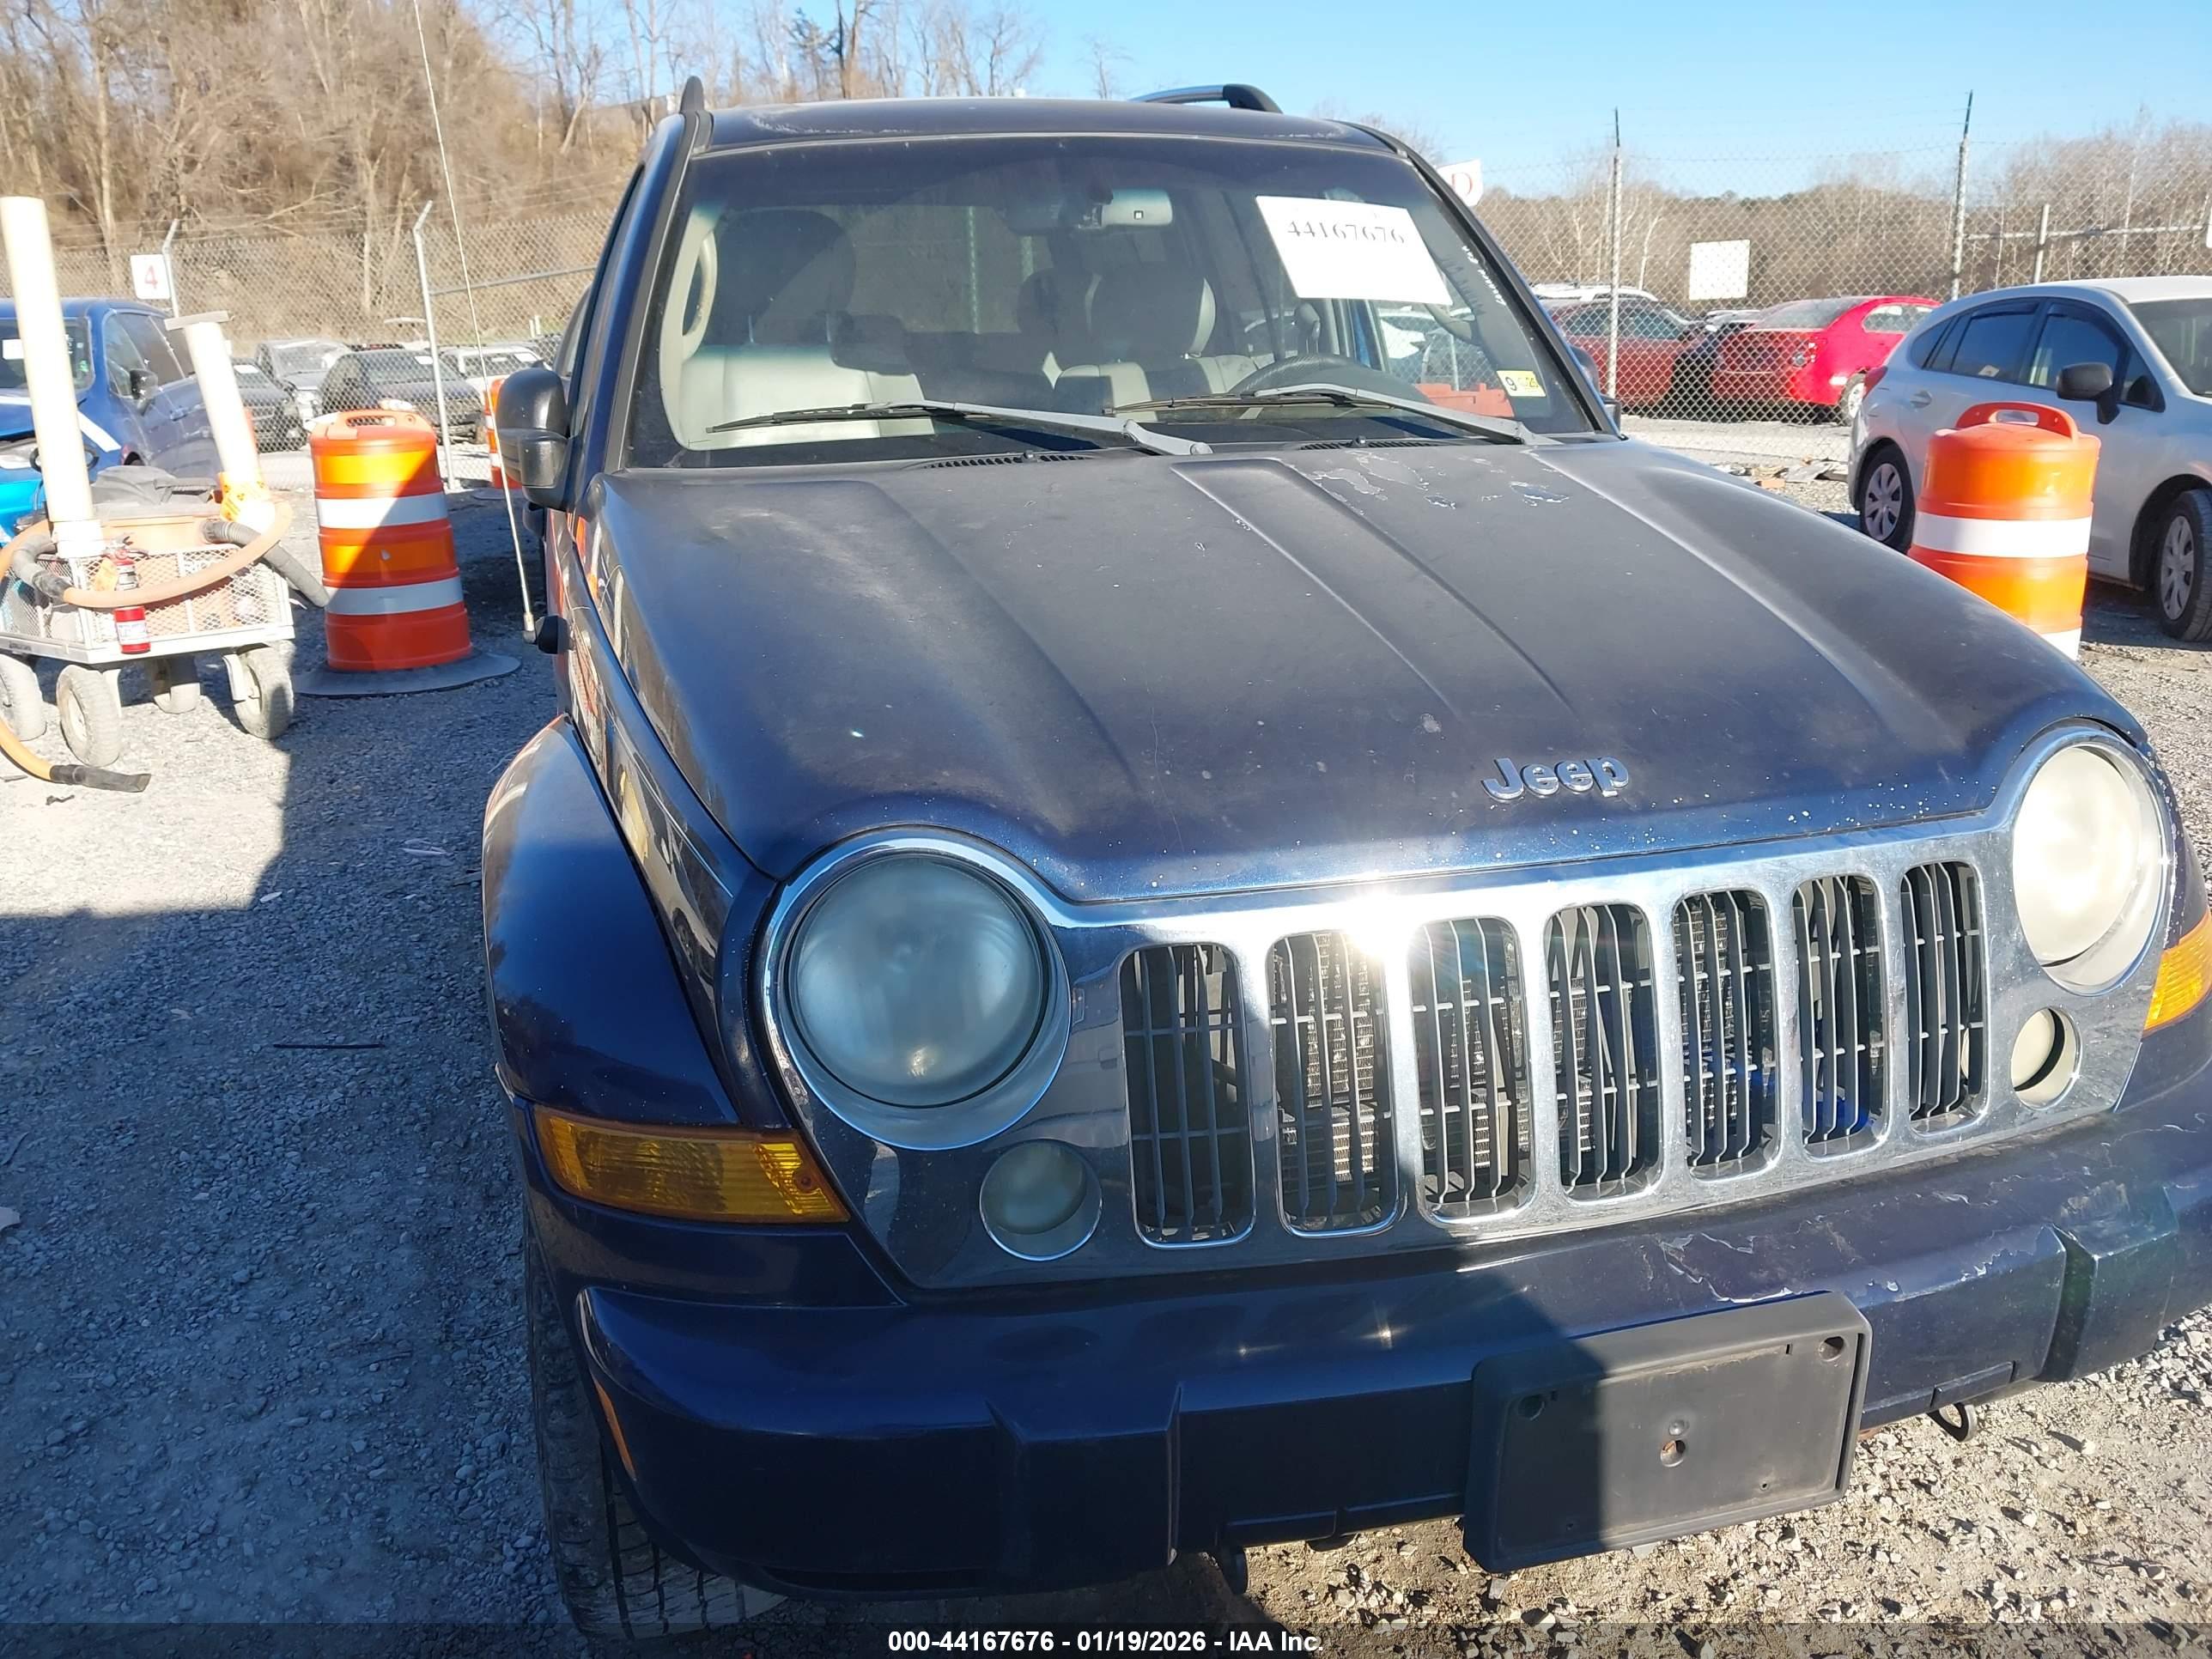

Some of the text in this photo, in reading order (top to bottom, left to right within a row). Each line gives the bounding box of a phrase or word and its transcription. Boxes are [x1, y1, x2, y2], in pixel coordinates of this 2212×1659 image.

[1287, 220, 1406, 244] 44167676
[144, 264, 159, 290] 4
[1504, 376, 1518, 392] 9
[1480, 757, 1629, 802] Jeep
